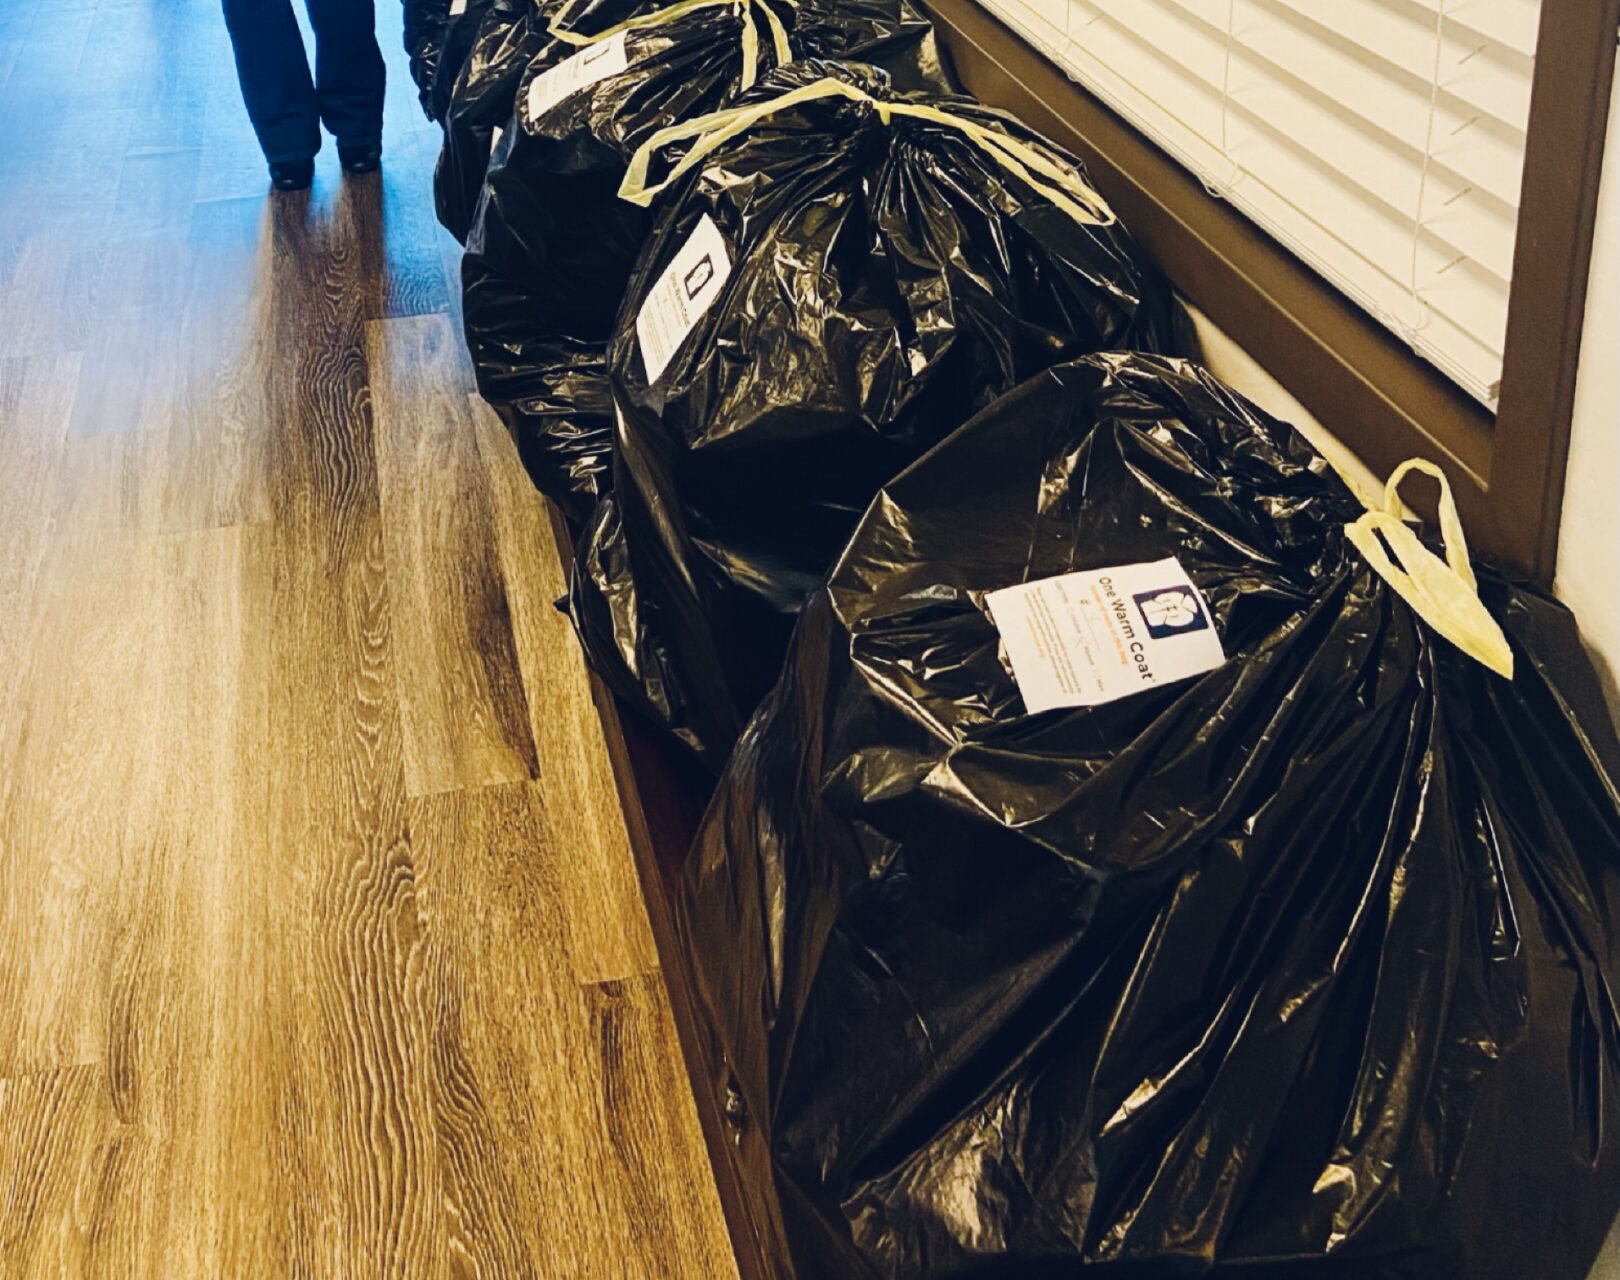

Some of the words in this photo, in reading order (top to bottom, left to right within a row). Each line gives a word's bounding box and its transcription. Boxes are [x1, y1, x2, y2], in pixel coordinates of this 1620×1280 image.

[1098, 576, 1116, 597] One
[1111, 598, 1135, 639] Warm
[1130, 641, 1153, 680] Coat
